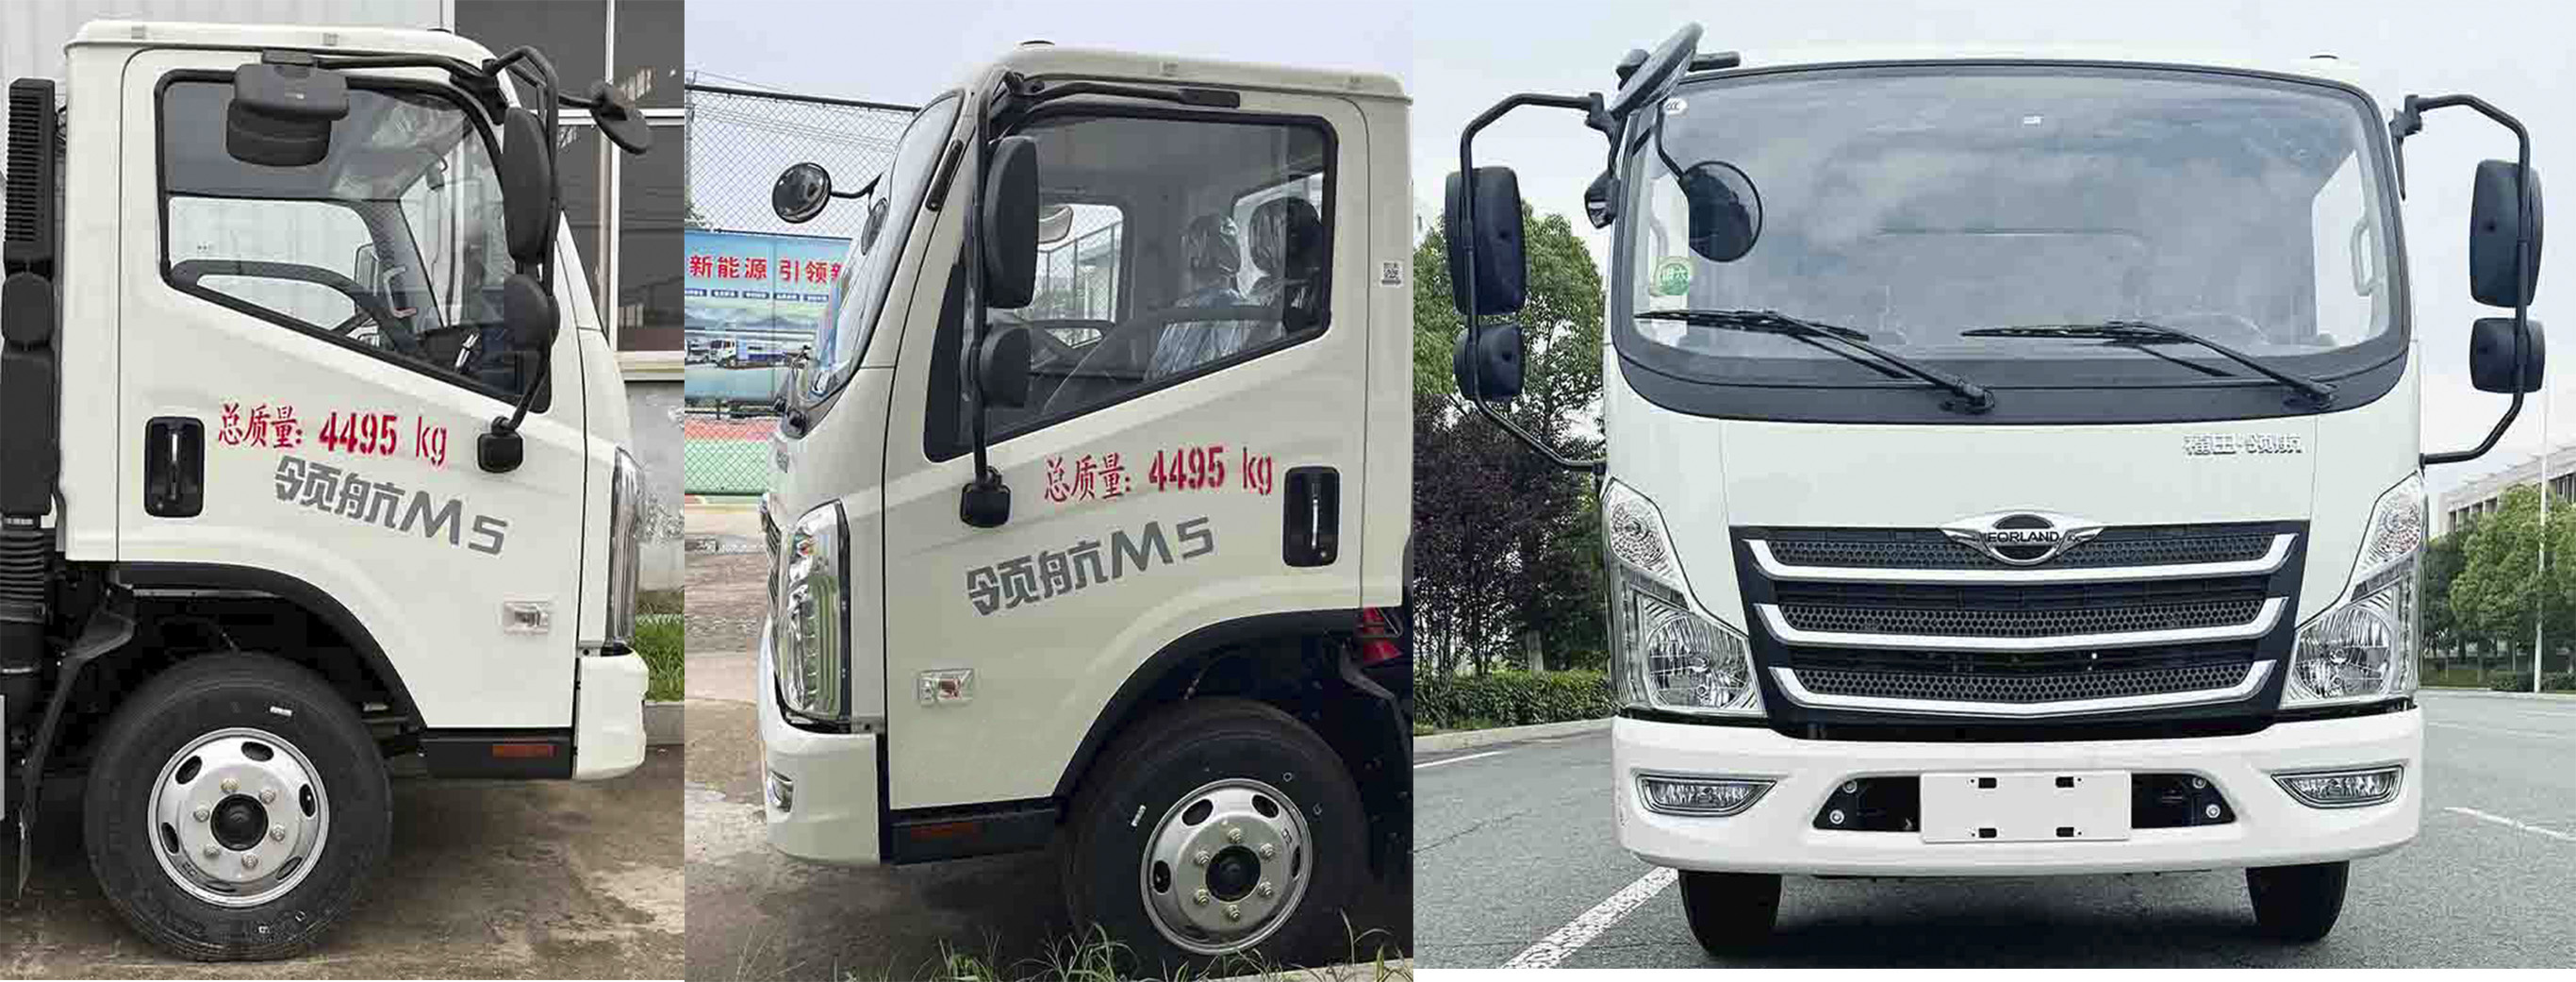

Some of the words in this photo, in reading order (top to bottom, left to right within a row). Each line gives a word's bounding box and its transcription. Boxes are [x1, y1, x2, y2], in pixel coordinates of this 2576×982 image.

[689, 255, 768, 280] 新能源
[318, 412, 398, 456] 4495
[415, 415, 448, 466] kg
[1148, 445, 1226, 491] 4495
[1242, 447, 1273, 495] kg
[1987, 531, 2059, 543] FORLAND
